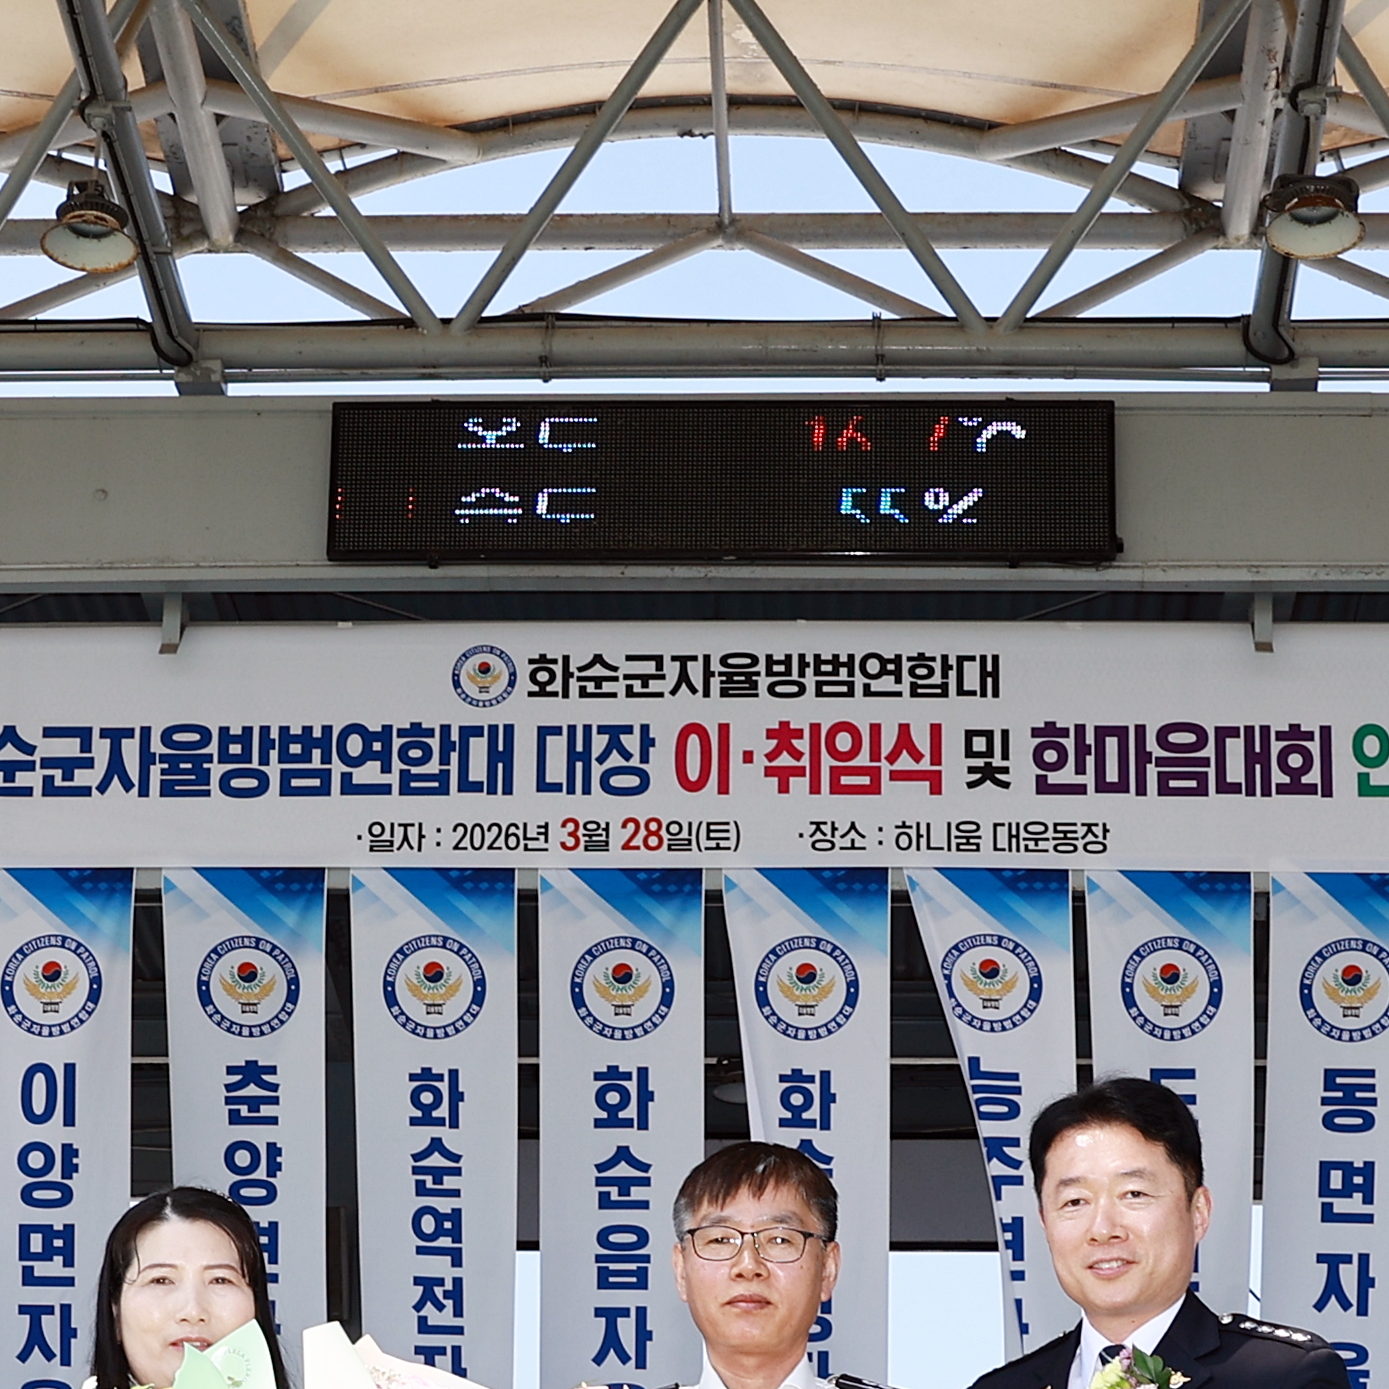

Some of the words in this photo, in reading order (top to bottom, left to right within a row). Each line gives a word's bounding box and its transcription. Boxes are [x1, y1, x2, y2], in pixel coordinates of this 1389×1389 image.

[527, 652, 999, 699] 화순군자율방범연합대
[538, 725, 654, 795] 대장
[675, 721, 942, 795] 이·취임식
[965, 729, 1011, 789] 및
[1031, 721, 1333, 798] 한마음대회
[453, 822, 549, 851] 2026년
[560, 818, 610, 852] 3월
[621, 817, 740, 852] 28일(토)
[895, 821, 982, 852] 하니움
[993, 821, 1110, 854] 대운동장
